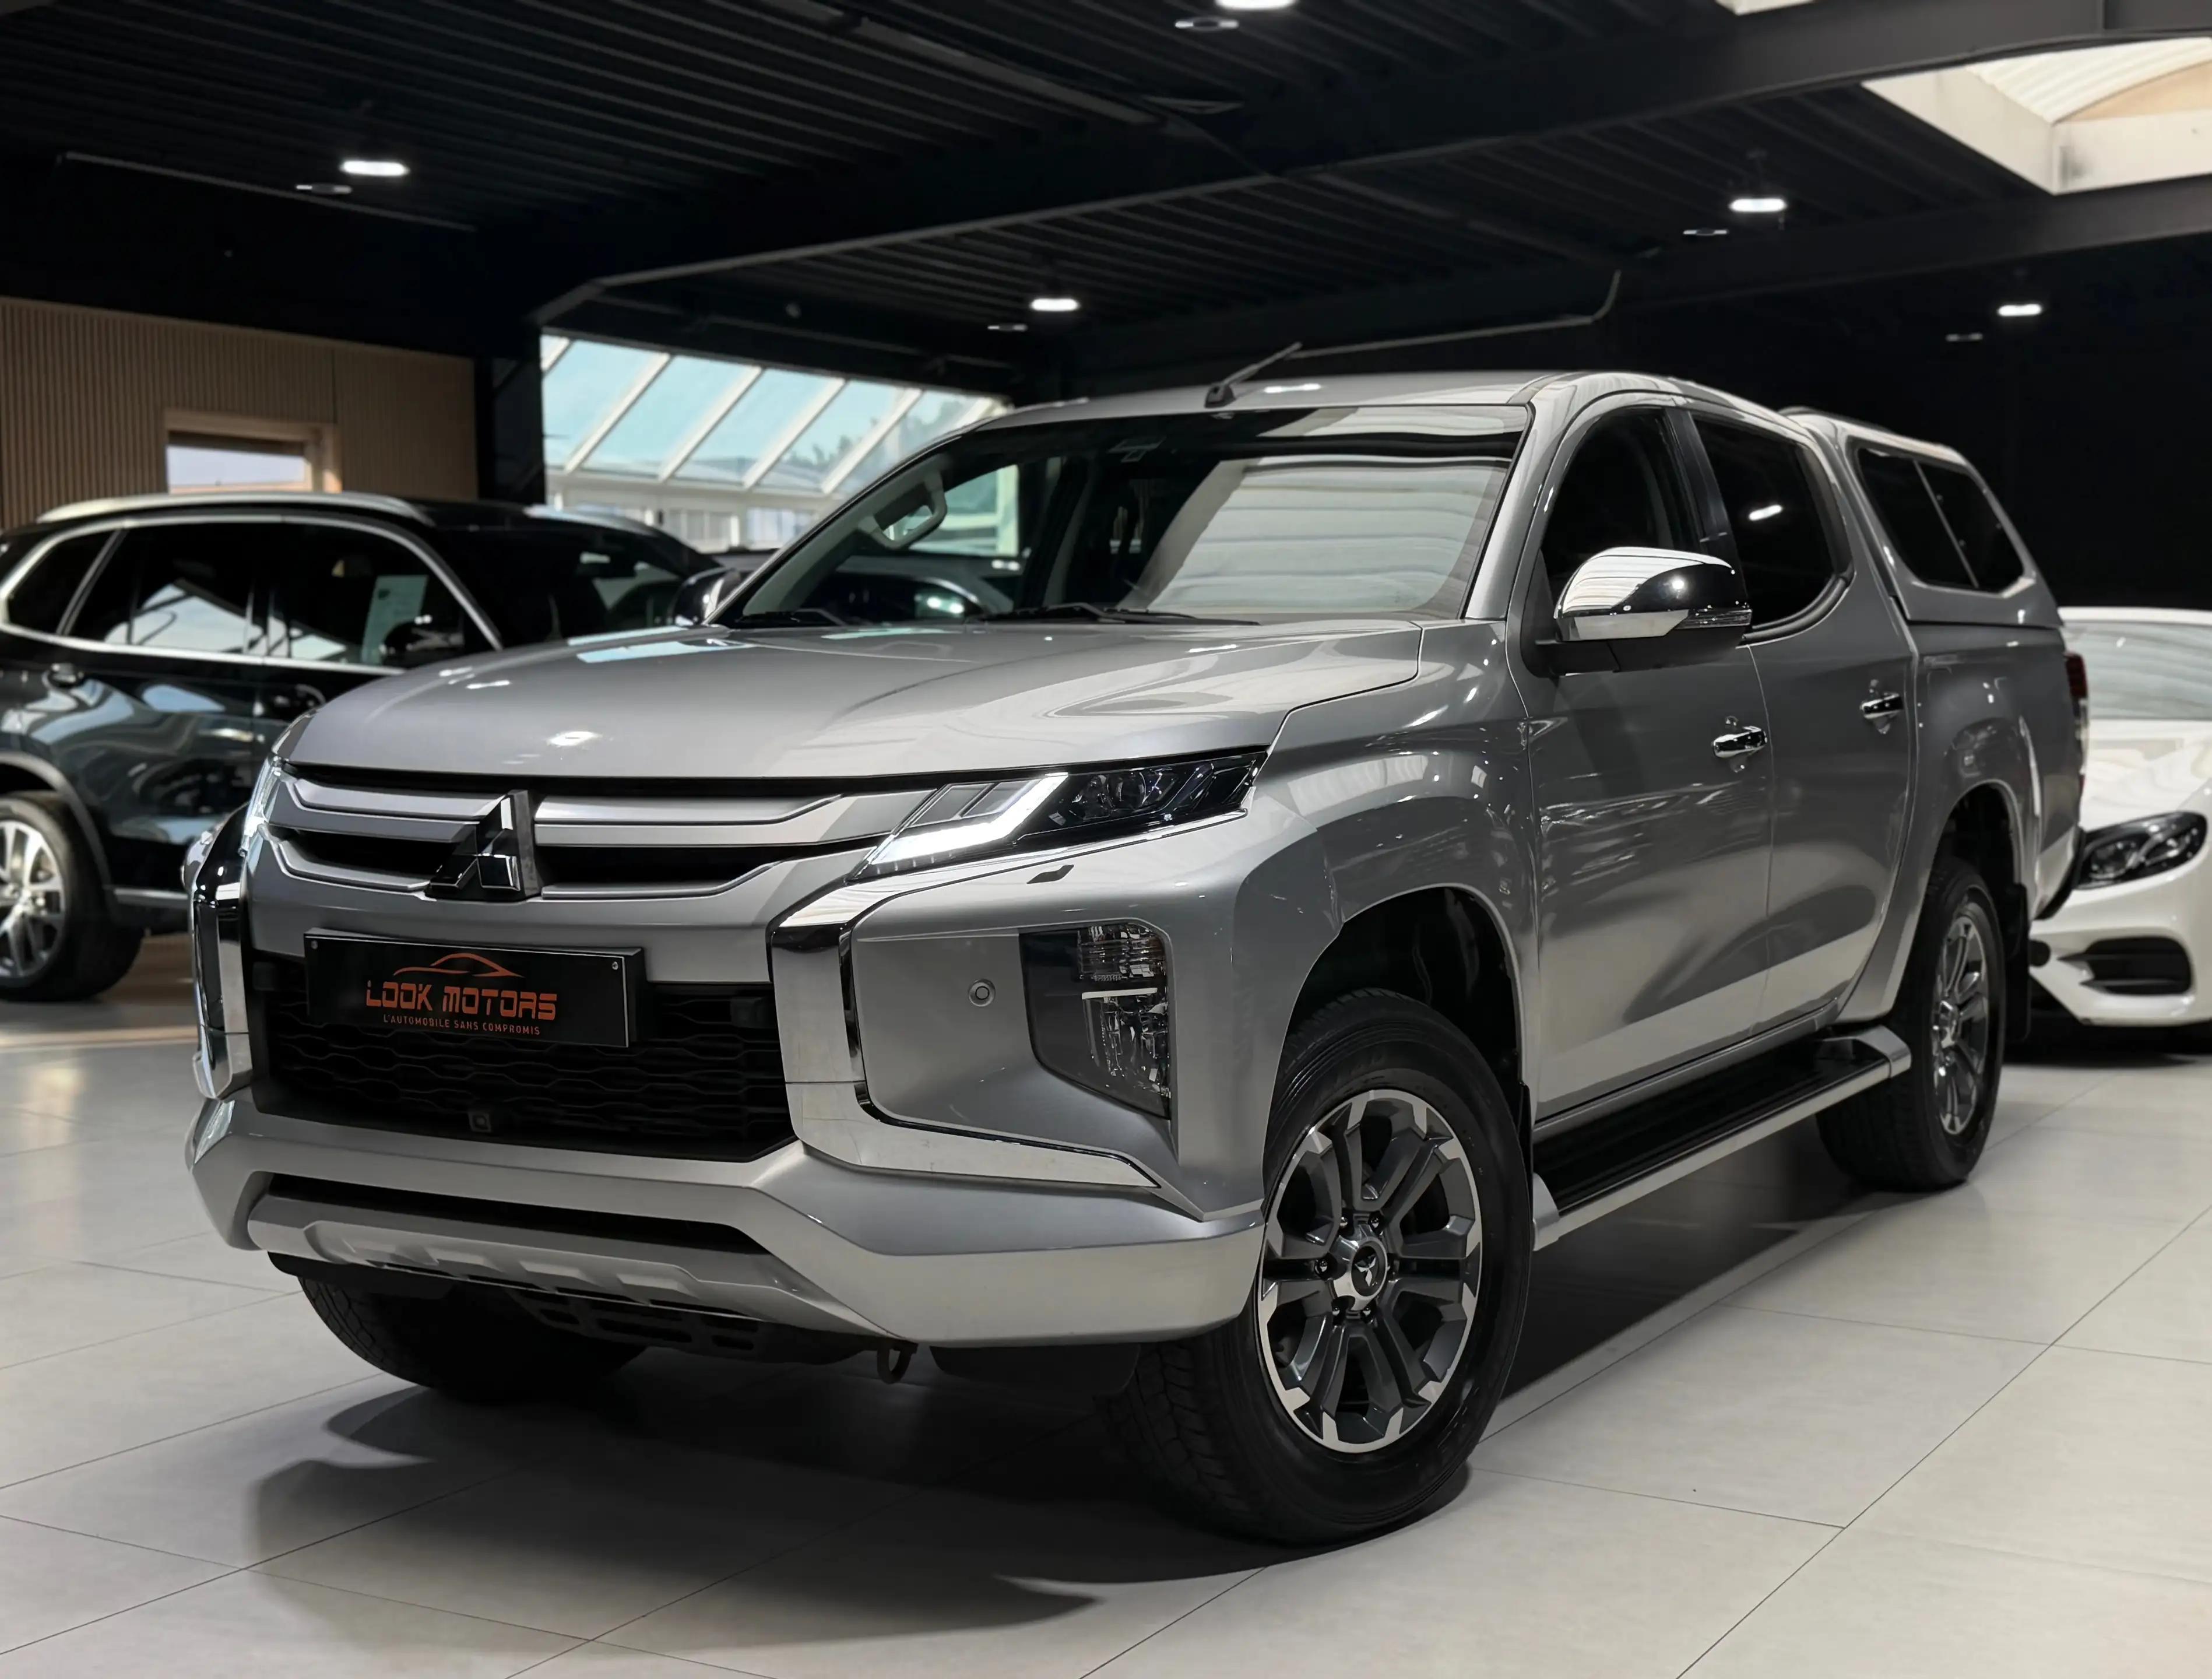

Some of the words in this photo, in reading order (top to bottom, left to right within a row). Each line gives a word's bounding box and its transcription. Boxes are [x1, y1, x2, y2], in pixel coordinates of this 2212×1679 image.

[365, 979, 433, 1012] LOOK
[442, 985, 558, 1021] MOTORS
[383, 1013, 450, 1028] L'AUTOMOBILE
[453, 1020, 479, 1030] SANS
[482, 1022, 541, 1035] COMPROMIS
